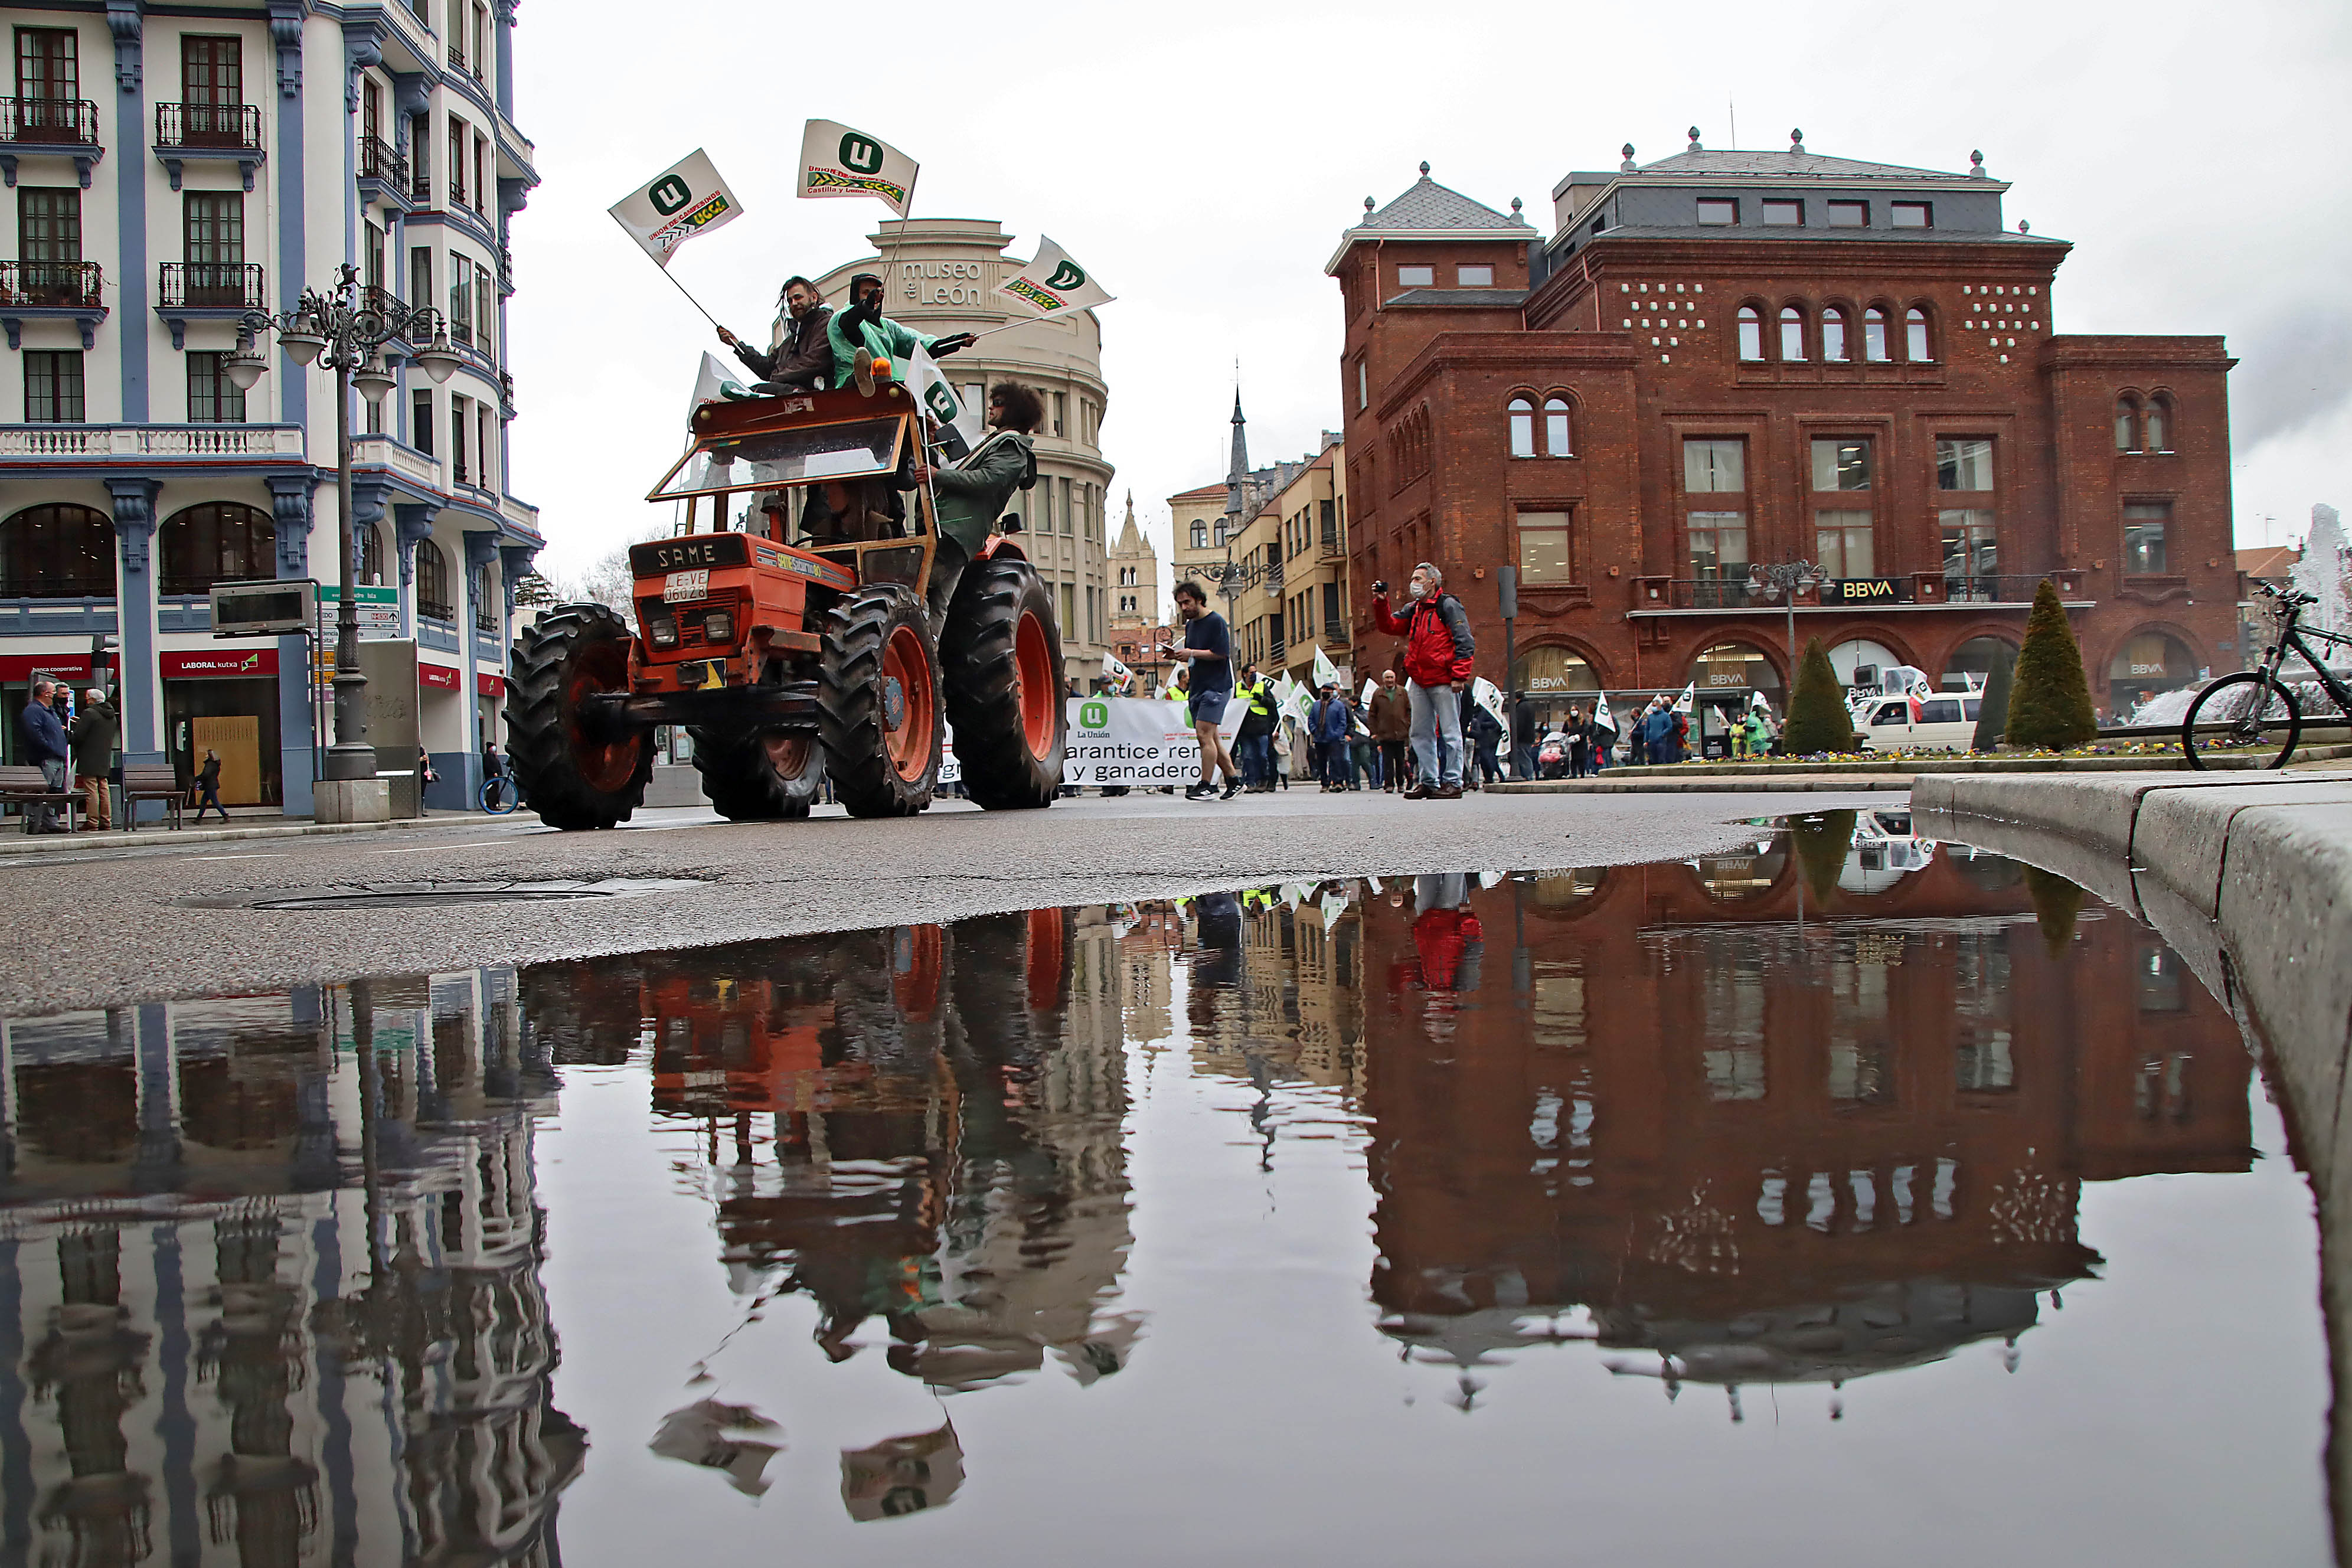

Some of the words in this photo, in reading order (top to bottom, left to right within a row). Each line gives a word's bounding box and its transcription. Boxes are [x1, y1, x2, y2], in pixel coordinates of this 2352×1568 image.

[648, 224, 669, 241] UNION
[668, 218, 679, 227] DE
[678, 190, 721, 221] CAMPESINOS
[903, 263, 981, 280] museo
[904, 282, 917, 299] de
[920, 280, 981, 306] León
[658, 544, 715, 567] SAME
[666, 572, 707, 588] LE-VE
[1843, 580, 1893, 597] BBVA
[2131, 664, 2164, 674] BBVA
[1531, 677, 1567, 689] BBVA
[1711, 674, 1743, 685] BBVA
[1066, 743, 1159, 759] arantice
[1168, 746, 1202, 759] ren
[1073, 766, 1086, 781] y
[1095, 762, 1202, 782] ganadero
